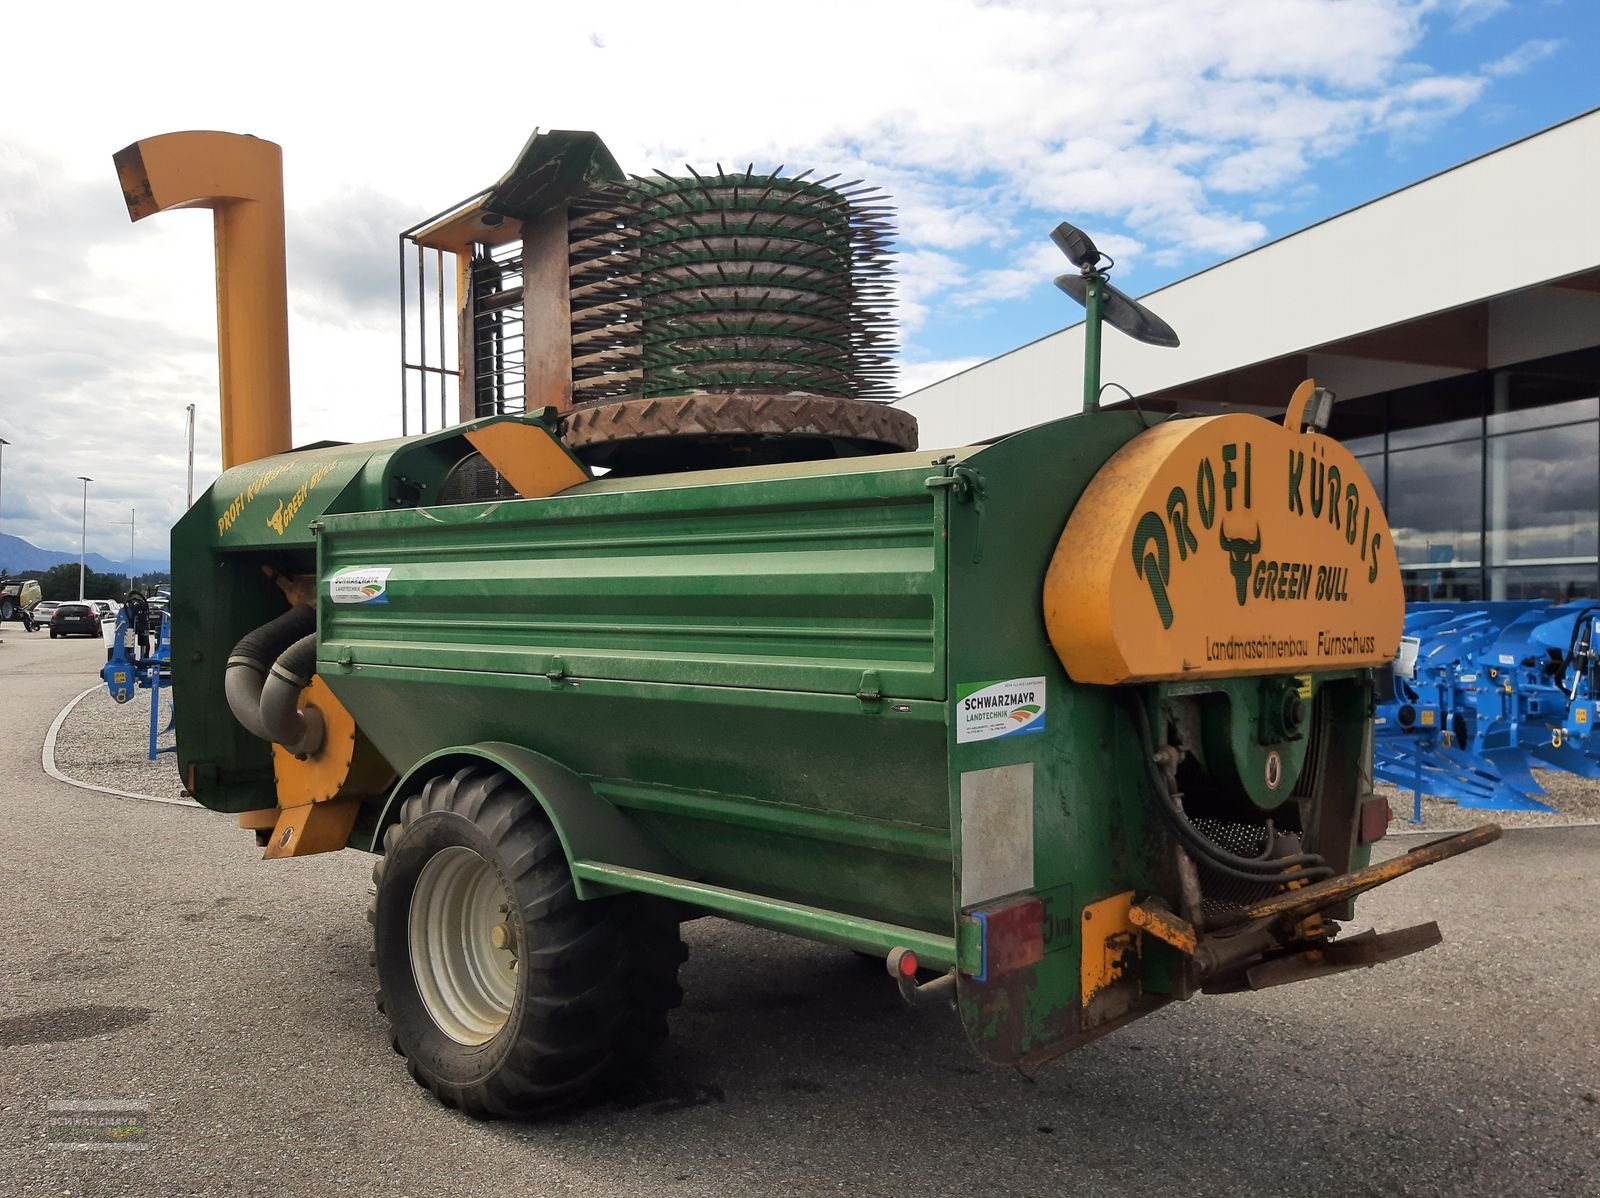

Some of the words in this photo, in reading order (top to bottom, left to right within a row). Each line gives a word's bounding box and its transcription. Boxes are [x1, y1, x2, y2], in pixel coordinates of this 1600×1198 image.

[218, 493, 244, 536] PROFI
[283, 482, 309, 528] GREEN
[1132, 442, 1251, 630] PROFI
[1288, 441, 1381, 584] KÜRBIS
[1253, 561, 1312, 601] GREEN
[1316, 565, 1348, 601] BULL
[1206, 636, 1308, 662] Landmaschinenbau
[1317, 630, 1376, 657] Fürnschuss
[965, 692, 1035, 710] SCHWARZMAYR
[966, 711, 1008, 722] LANDTECHNIK
